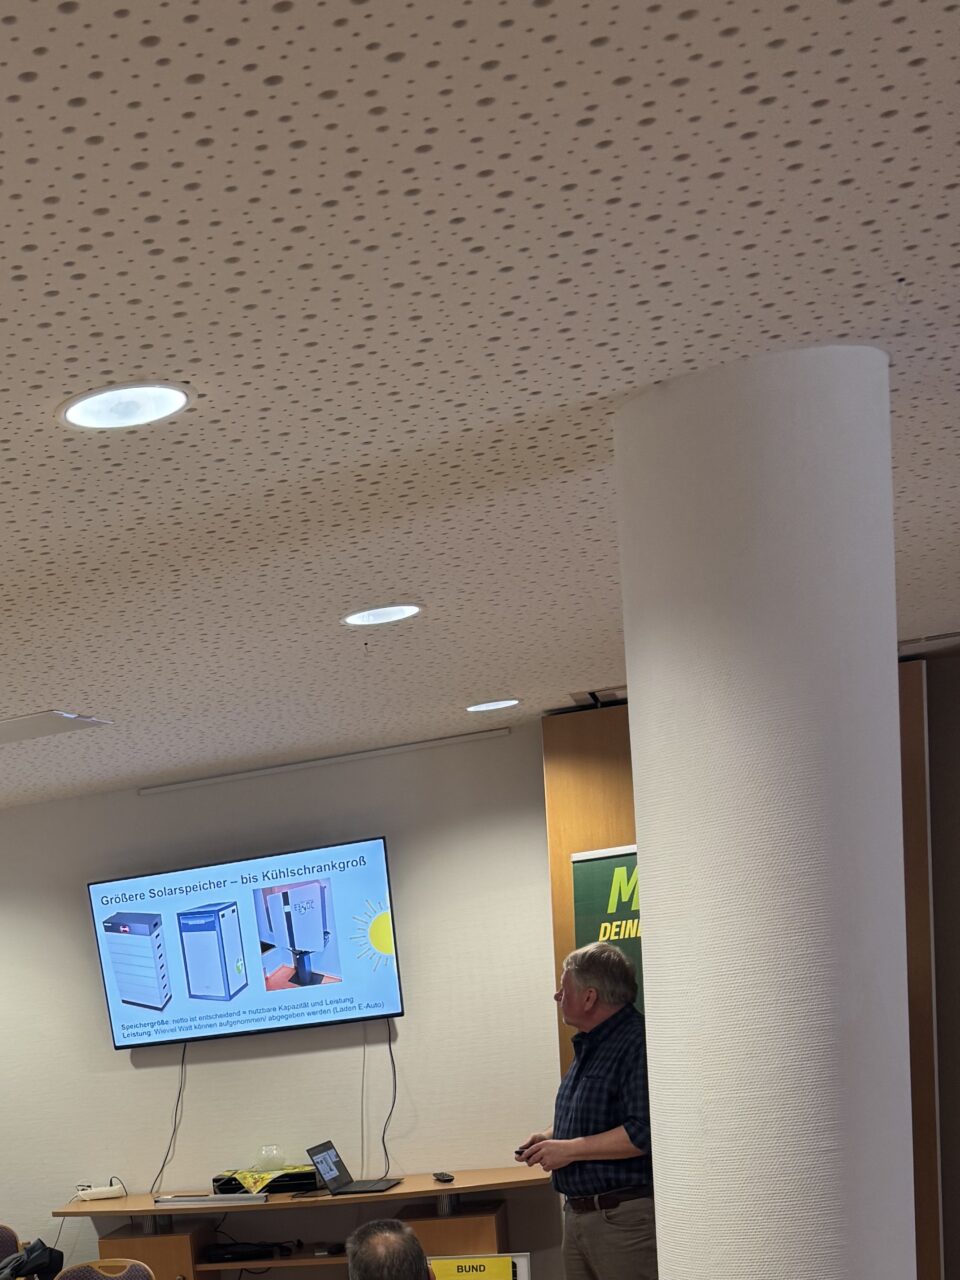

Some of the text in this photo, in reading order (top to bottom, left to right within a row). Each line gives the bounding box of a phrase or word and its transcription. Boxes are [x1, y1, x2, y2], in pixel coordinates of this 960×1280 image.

[101, 892, 146, 905] Größere
[148, 879, 228, 899] Solarspeicher
[241, 874, 258, 885] bis
[262, 856, 367, 881] Kühlschrankgroß
[598, 919, 642, 941] DEIN
[278, 1002, 310, 1013] Kapazität
[311, 1000, 324, 1008] und
[325, 997, 354, 1006] Leistung
[456, 1264, 486, 1273] BUND
